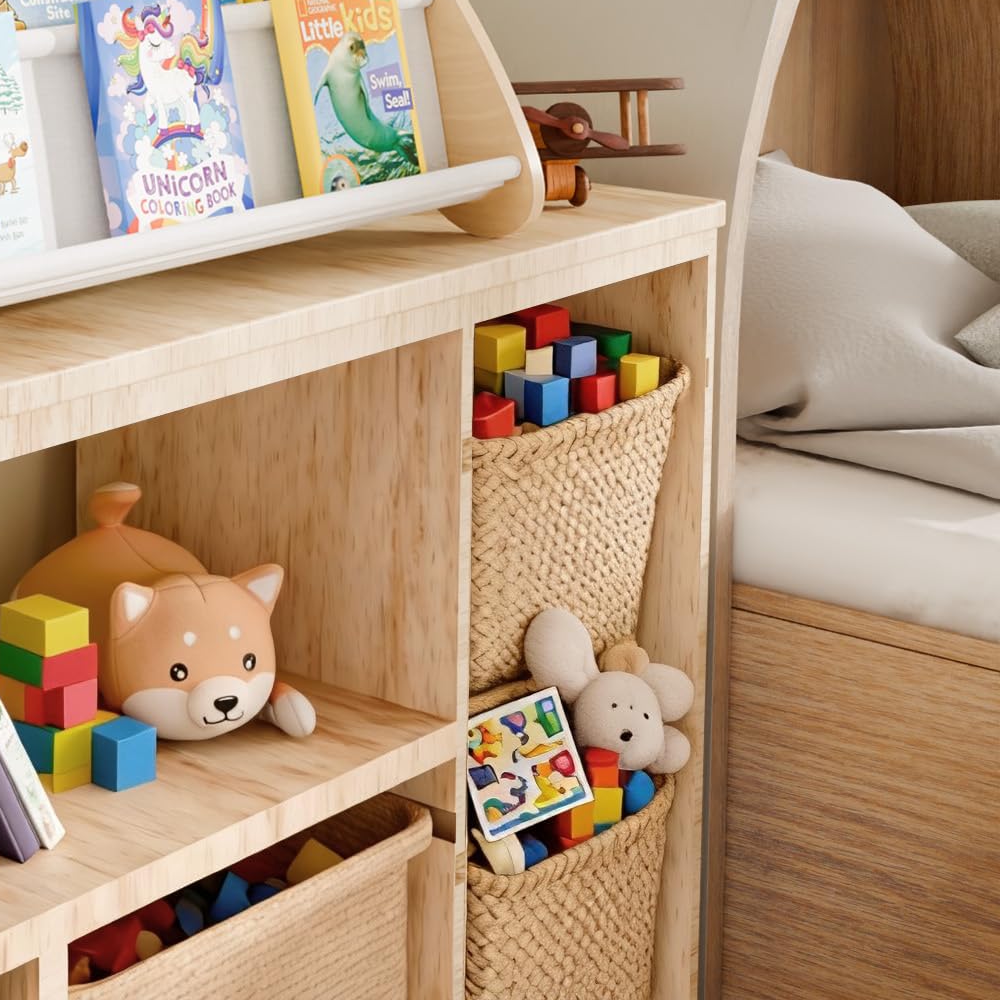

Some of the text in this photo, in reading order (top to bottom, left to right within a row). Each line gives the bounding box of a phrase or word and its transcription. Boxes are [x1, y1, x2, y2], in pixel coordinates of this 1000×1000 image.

[46, 5, 72, 20] Site
[300, 16, 344, 42] Little
[370, 71, 402, 90] Swim,
[384, 89, 411, 109] Seal!
[206, 181, 237, 208] BOOK
